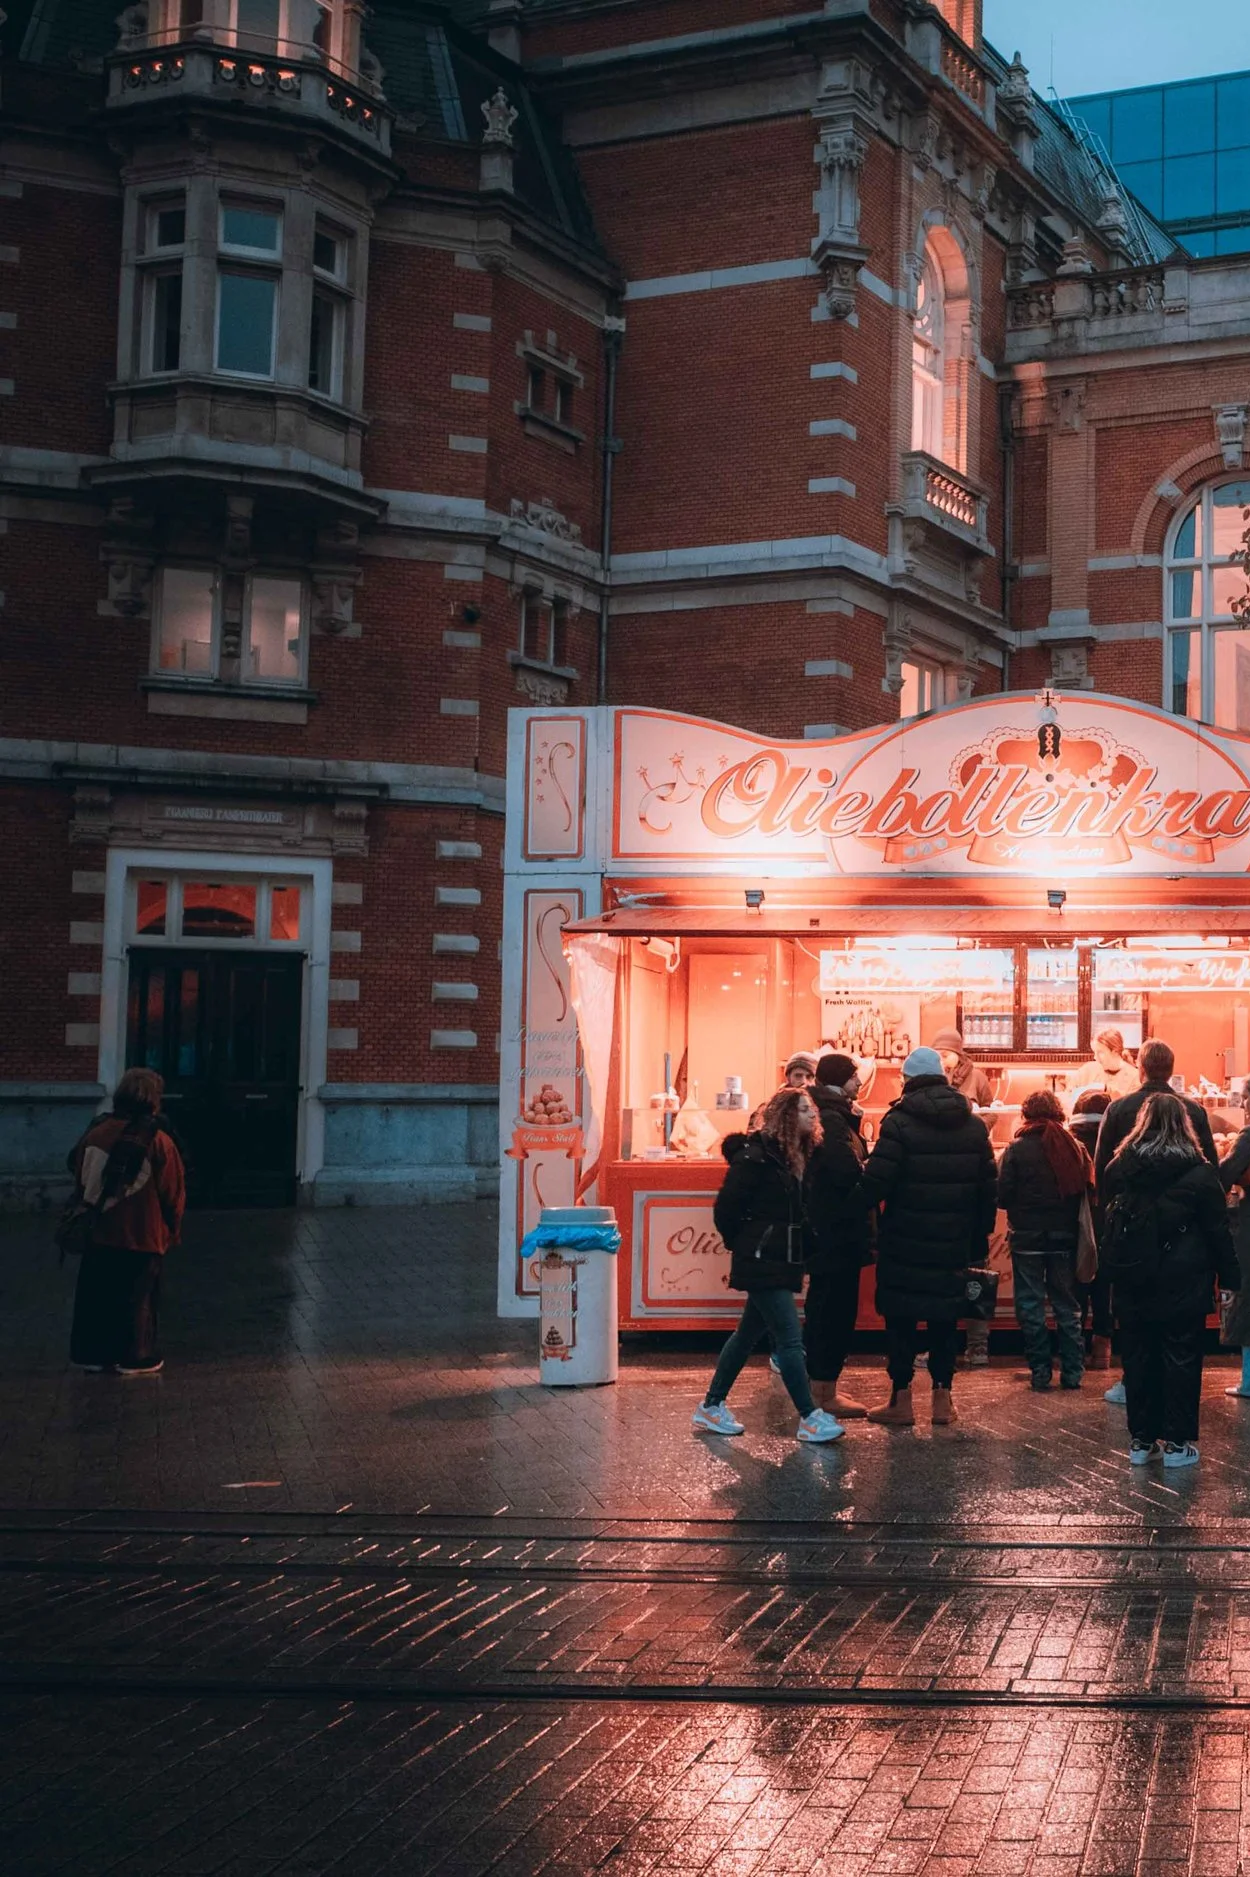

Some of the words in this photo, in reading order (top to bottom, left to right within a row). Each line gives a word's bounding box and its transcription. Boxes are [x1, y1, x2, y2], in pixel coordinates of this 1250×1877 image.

[994, 841, 1105, 860] Amtdam
[825, 998, 844, 1006] Fresh
[821, 1032, 909, 1058] utella
[666, 1226, 733, 1255] Olie
